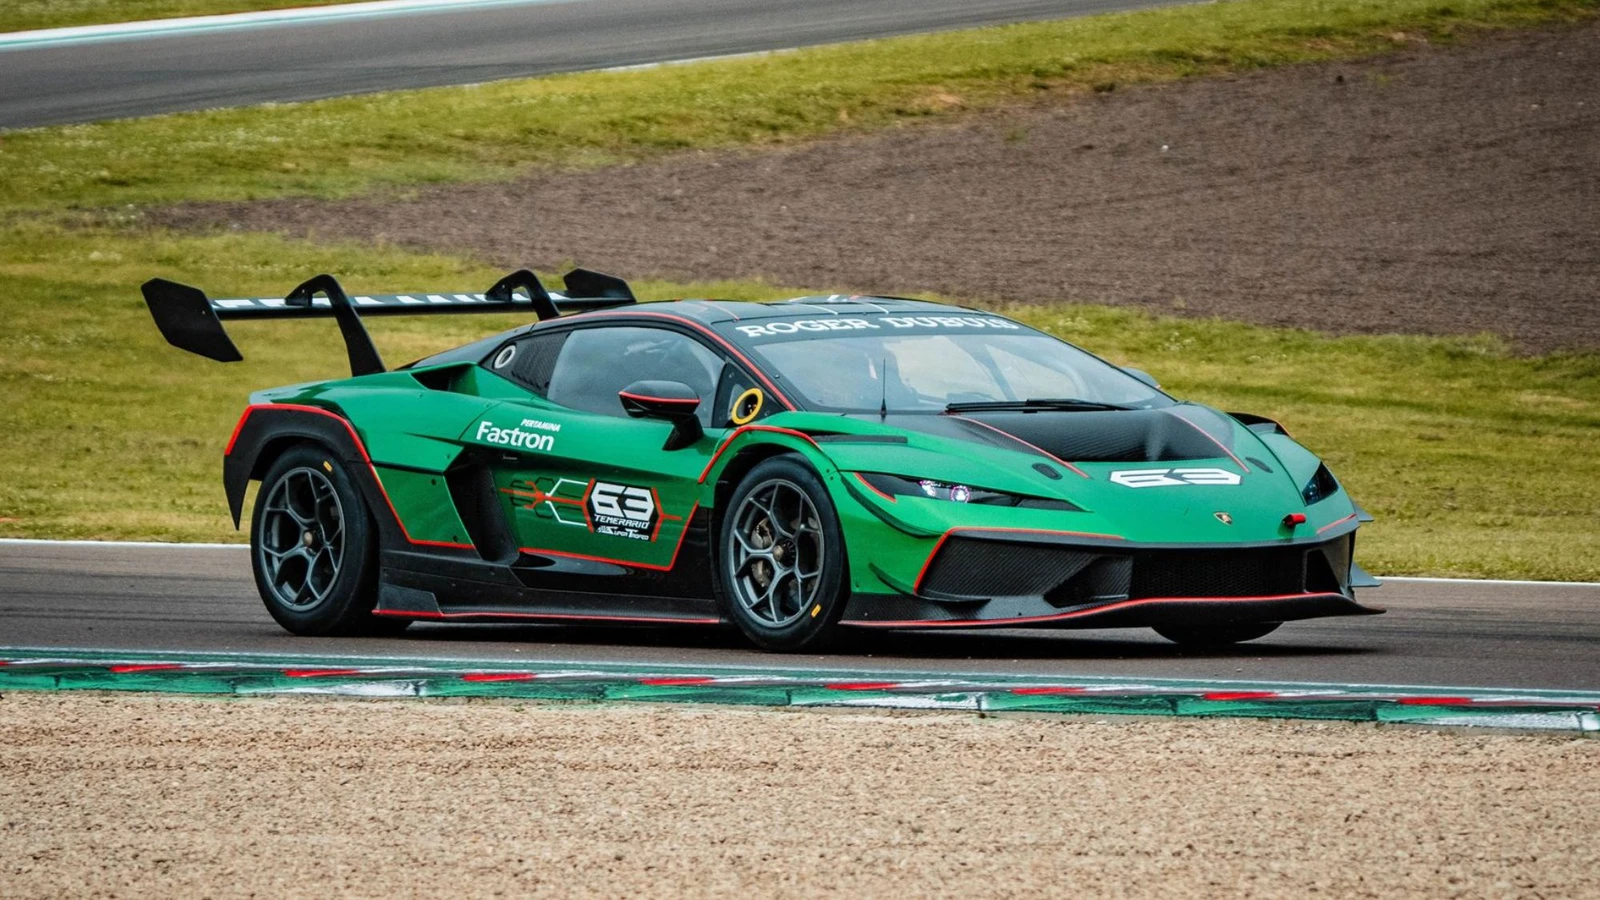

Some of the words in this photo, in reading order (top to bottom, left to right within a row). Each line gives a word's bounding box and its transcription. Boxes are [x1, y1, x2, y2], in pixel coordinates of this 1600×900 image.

[736, 318, 880, 337] ROGER
[879, 317, 1019, 329] DUBUIS
[521, 418, 561, 432] PERTAMINA
[476, 420, 554, 451] Fastron
[1110, 468, 1241, 488] 63
[591, 482, 655, 521] 63
[594, 513, 650, 529] TEMERARIO
